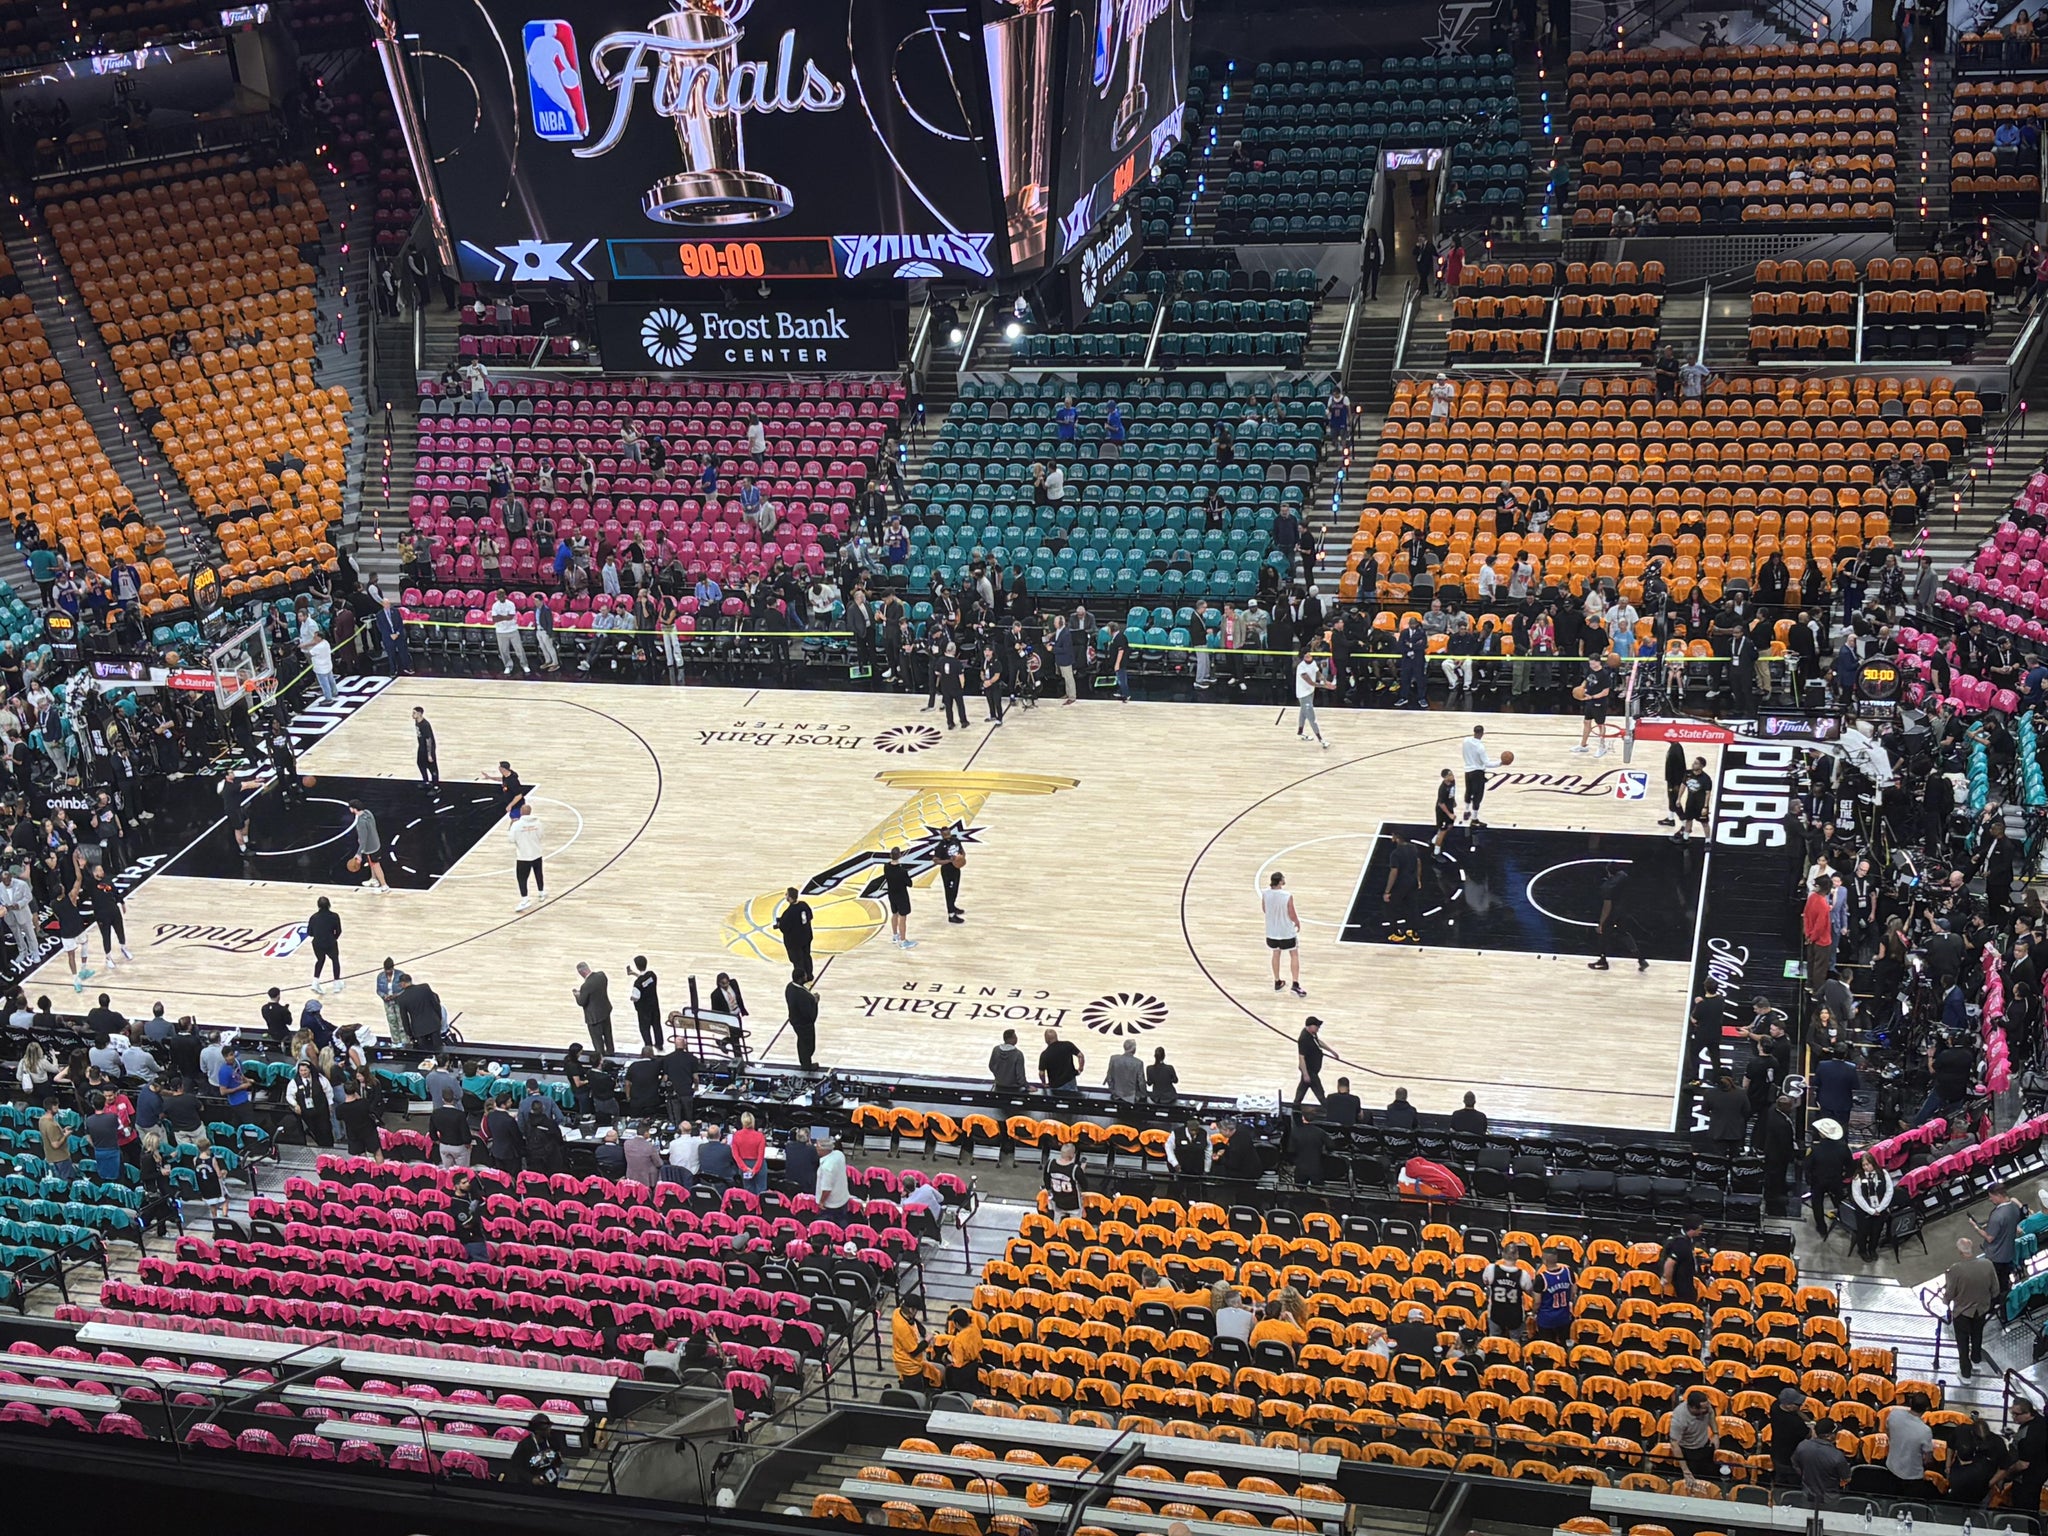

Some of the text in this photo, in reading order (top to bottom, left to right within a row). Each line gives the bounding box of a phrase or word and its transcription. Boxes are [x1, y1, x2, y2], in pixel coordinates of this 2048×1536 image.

[100, 56, 132, 74] Finals
[572, 26, 846, 158] Finals
[539, 112, 567, 132] NBA
[1392, 152, 1424, 169] Finals
[679, 243, 764, 277] 90:00
[700, 307, 849, 339] Frost Bank
[724, 349, 828, 362] CENTER
[1863, 669, 1895, 681] 90:00
[733, 720, 851, 731] CENTER
[1773, 719, 1812, 736] Finals
[693, 730, 868, 750] Frost Bank
[46, 796, 89, 810] coinba
[151, 921, 309, 954] Finals
[902, 981, 1050, 1000] CENTER
[855, 995, 1072, 1028] Frost Bank
[1494, 1286, 1518, 1304] 24
[1552, 1290, 1568, 1309] 11
